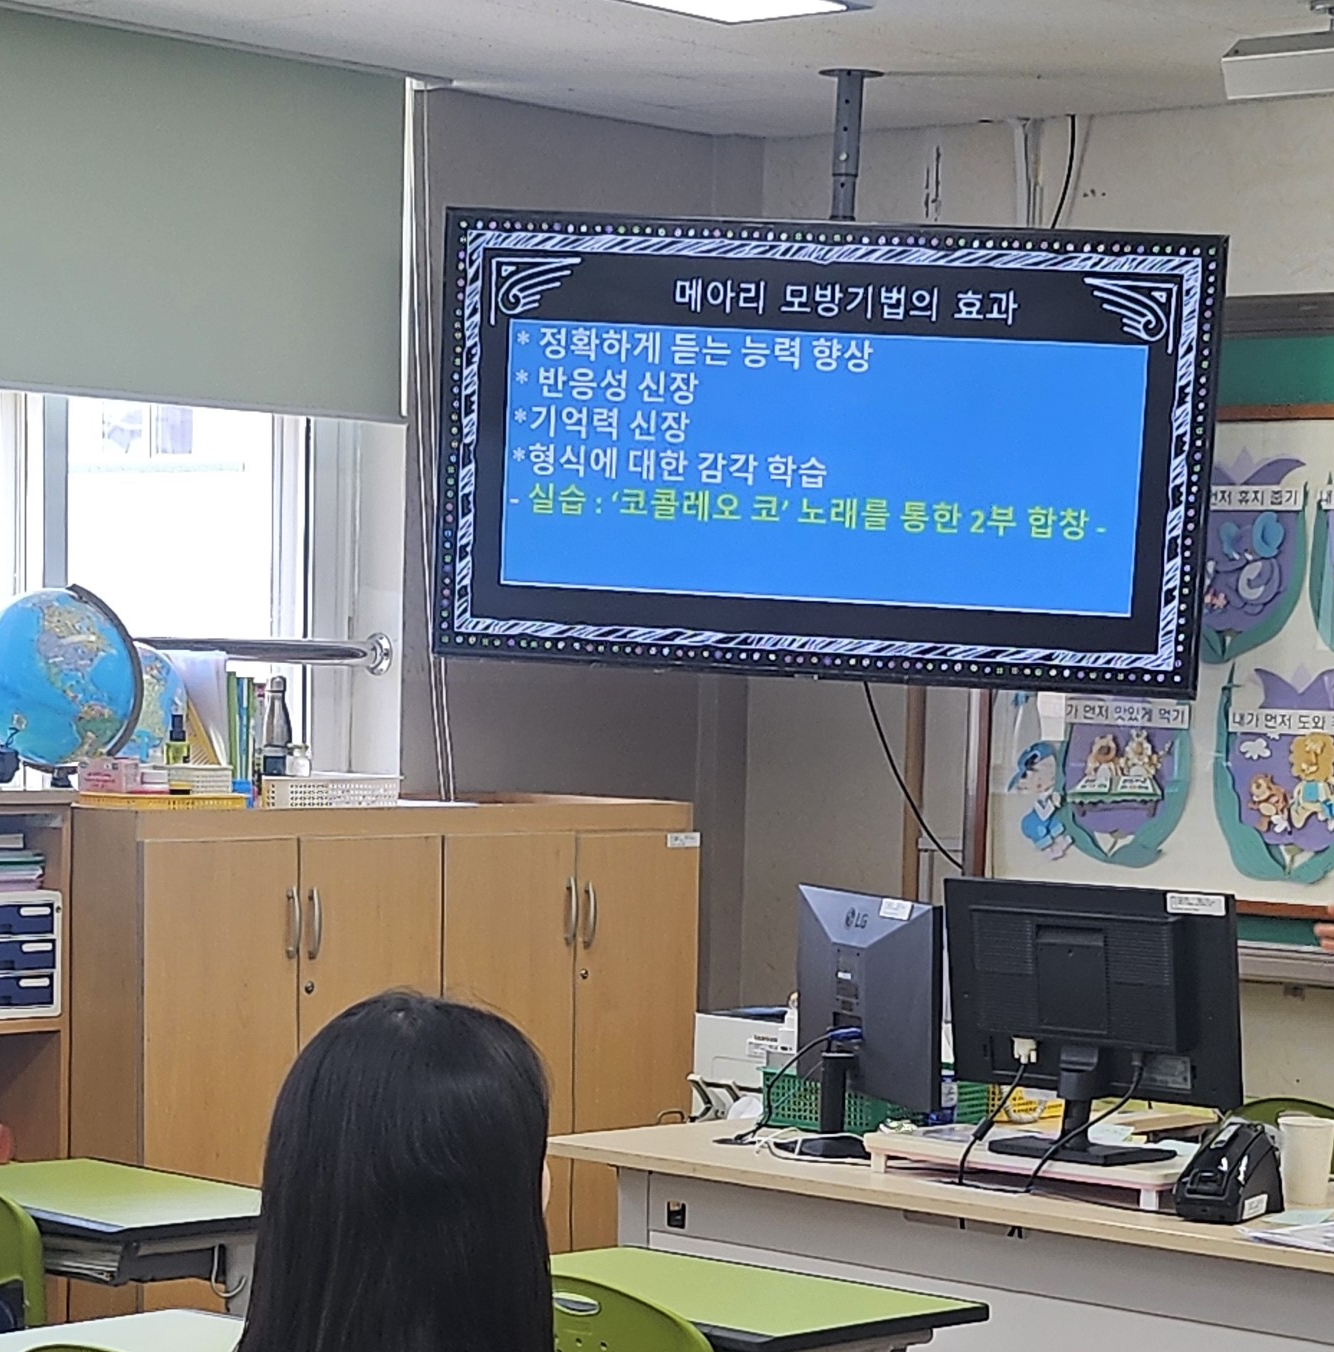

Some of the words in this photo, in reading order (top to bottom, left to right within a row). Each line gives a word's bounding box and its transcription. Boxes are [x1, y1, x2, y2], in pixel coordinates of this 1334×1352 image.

[675, 279, 765, 314] 메아리
[780, 284, 939, 322] 모방기법의
[953, 290, 1018, 326] 효과
[538, 327, 662, 364] 정확하게
[670, 333, 732, 367] 듣는
[740, 336, 802, 370] 능력
[812, 338, 874, 373] 향상
[537, 366, 629, 400] 반응성
[637, 372, 699, 405] 신장
[628, 411, 690, 444] 신장
[627, 448, 688, 483] 대한
[696, 450, 759, 486] 감각
[767, 455, 828, 489] 학습
[528, 482, 587, 516] 실습
[798, 496, 891, 532] 노래를
[900, 500, 963, 536] 통한
[968, 505, 1019, 538] 2부
[1027, 506, 1090, 543] 합창
[1239, 490, 1265, 507] 휴지
[1082, 704, 1109, 721] 먼저
[1114, 705, 1153, 723] 맛있게
[1158, 707, 1186, 724] 먹기
[1232, 712, 1260, 727] 내가
[1264, 713, 1292, 730] 먼저
[1297, 714, 1326, 731] 도와
[854, 912, 869, 929] LG
